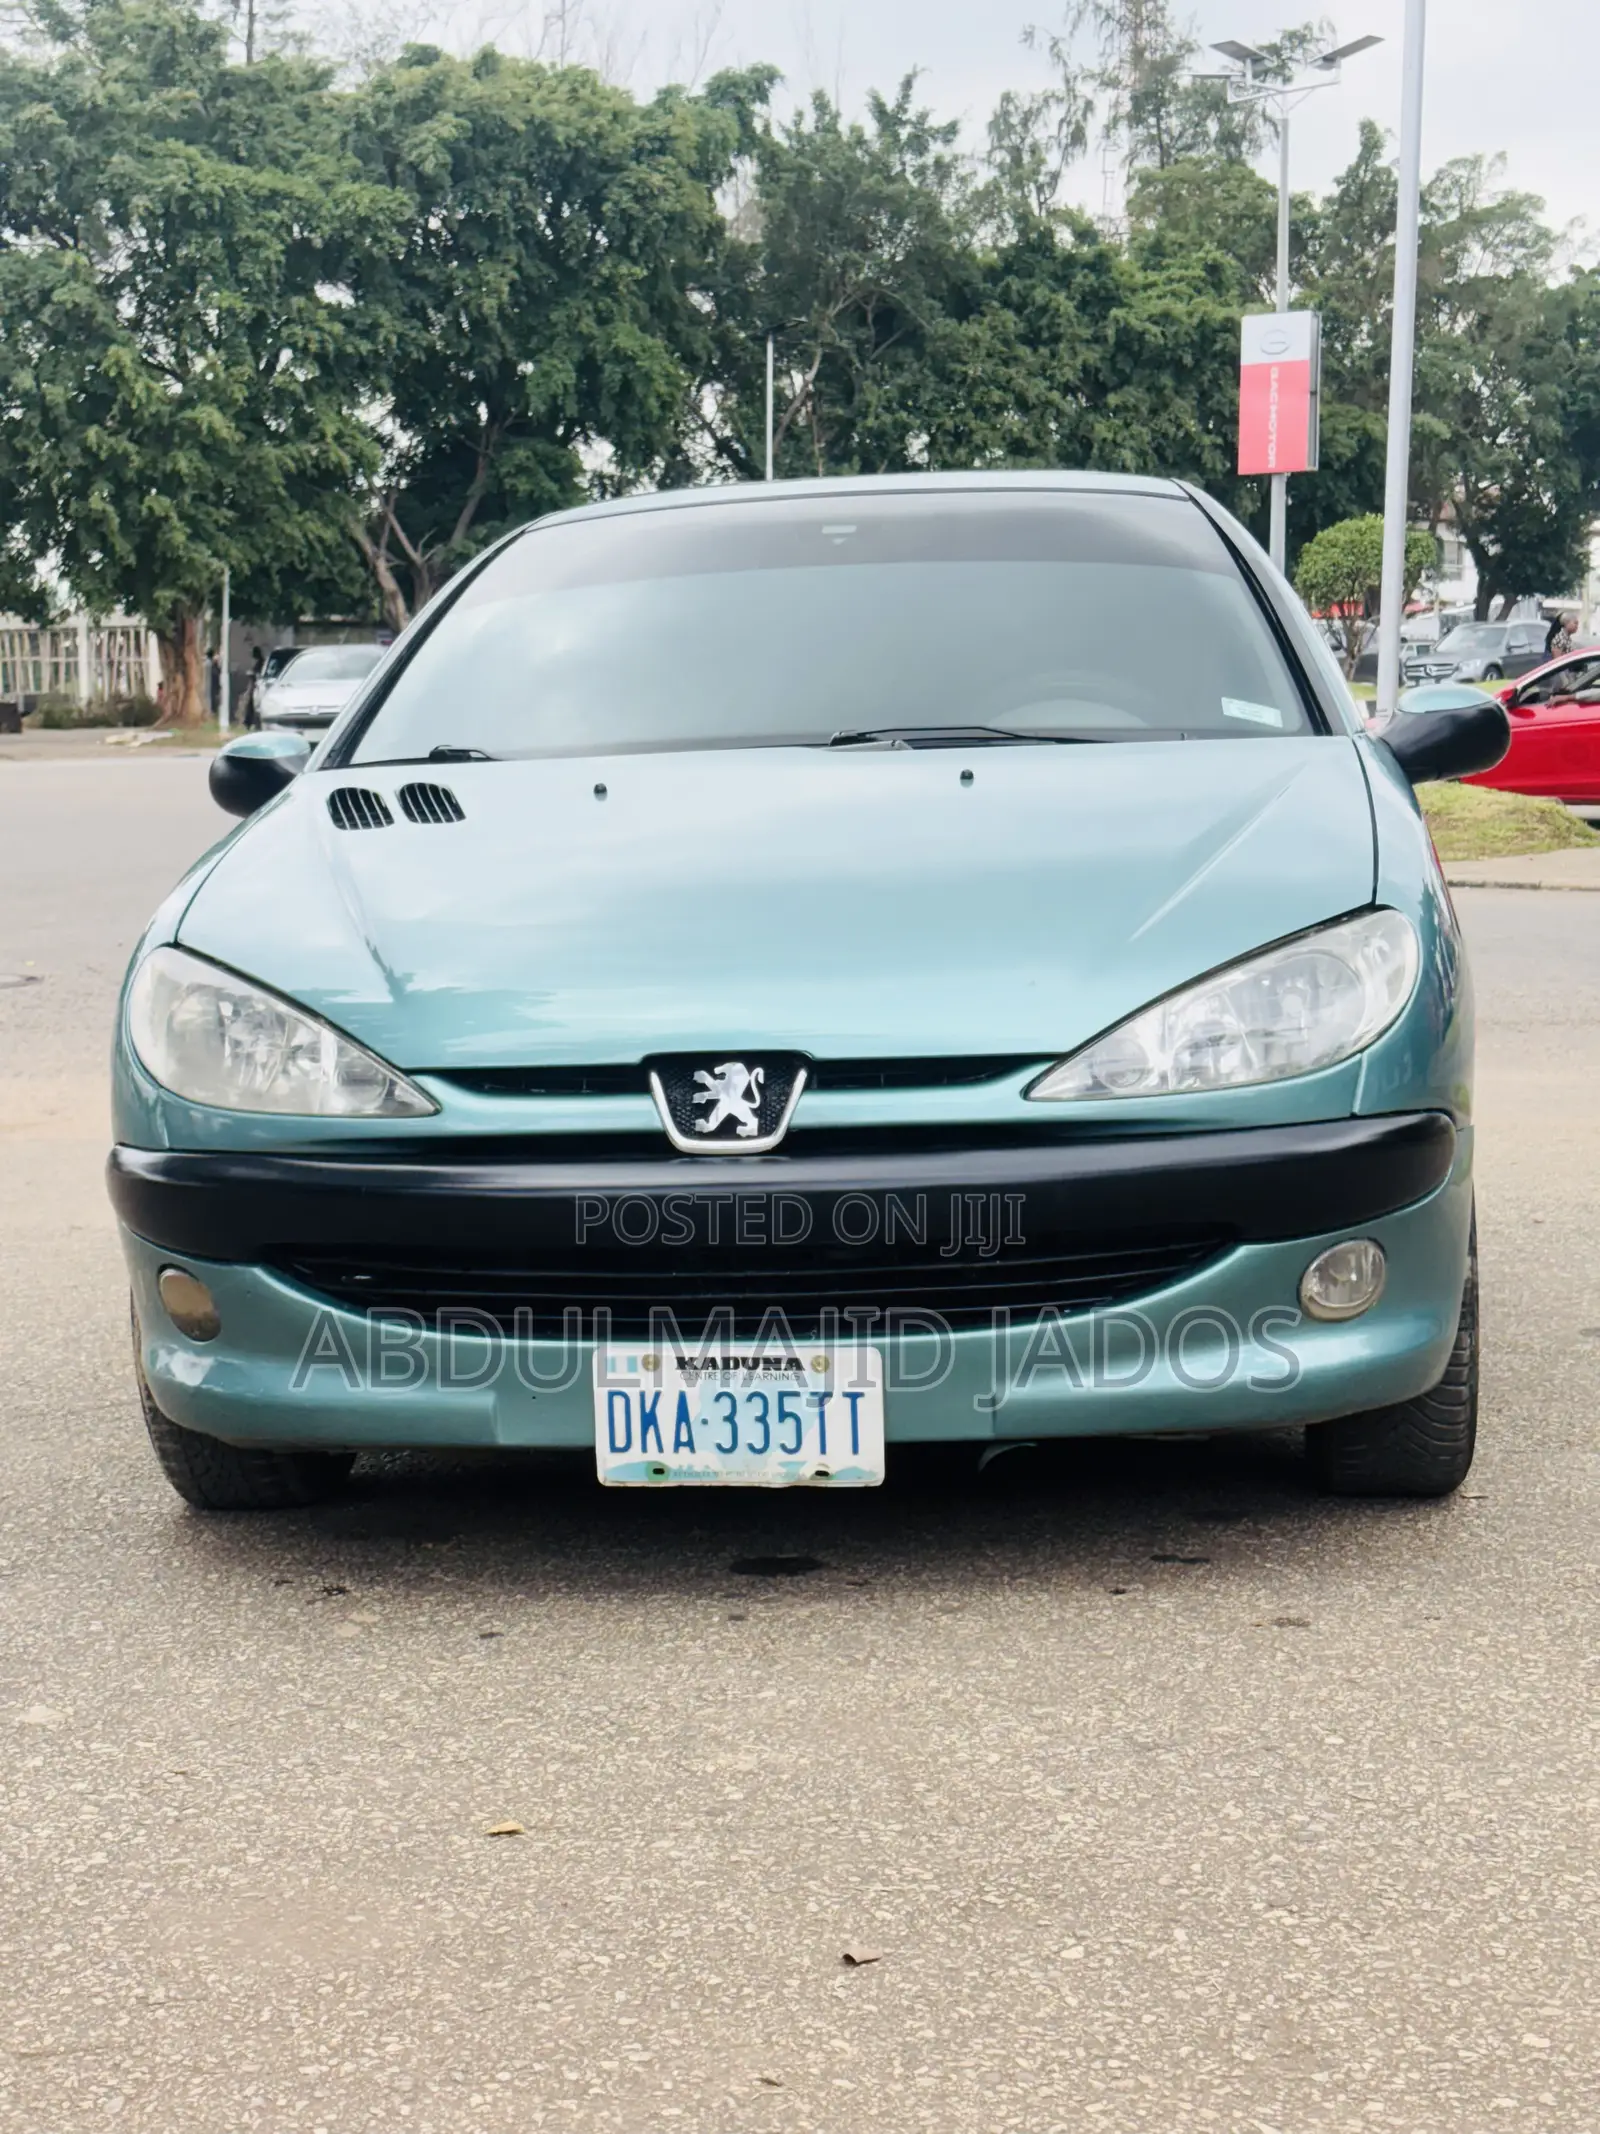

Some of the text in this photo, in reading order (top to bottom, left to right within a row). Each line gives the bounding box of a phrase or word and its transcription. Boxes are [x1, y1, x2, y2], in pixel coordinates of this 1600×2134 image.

[1267, 404, 1279, 469] MOTOR
[675, 1356, 805, 1371] KADUNA
[680, 1371, 801, 1381] CENTRE OF LEARNING
